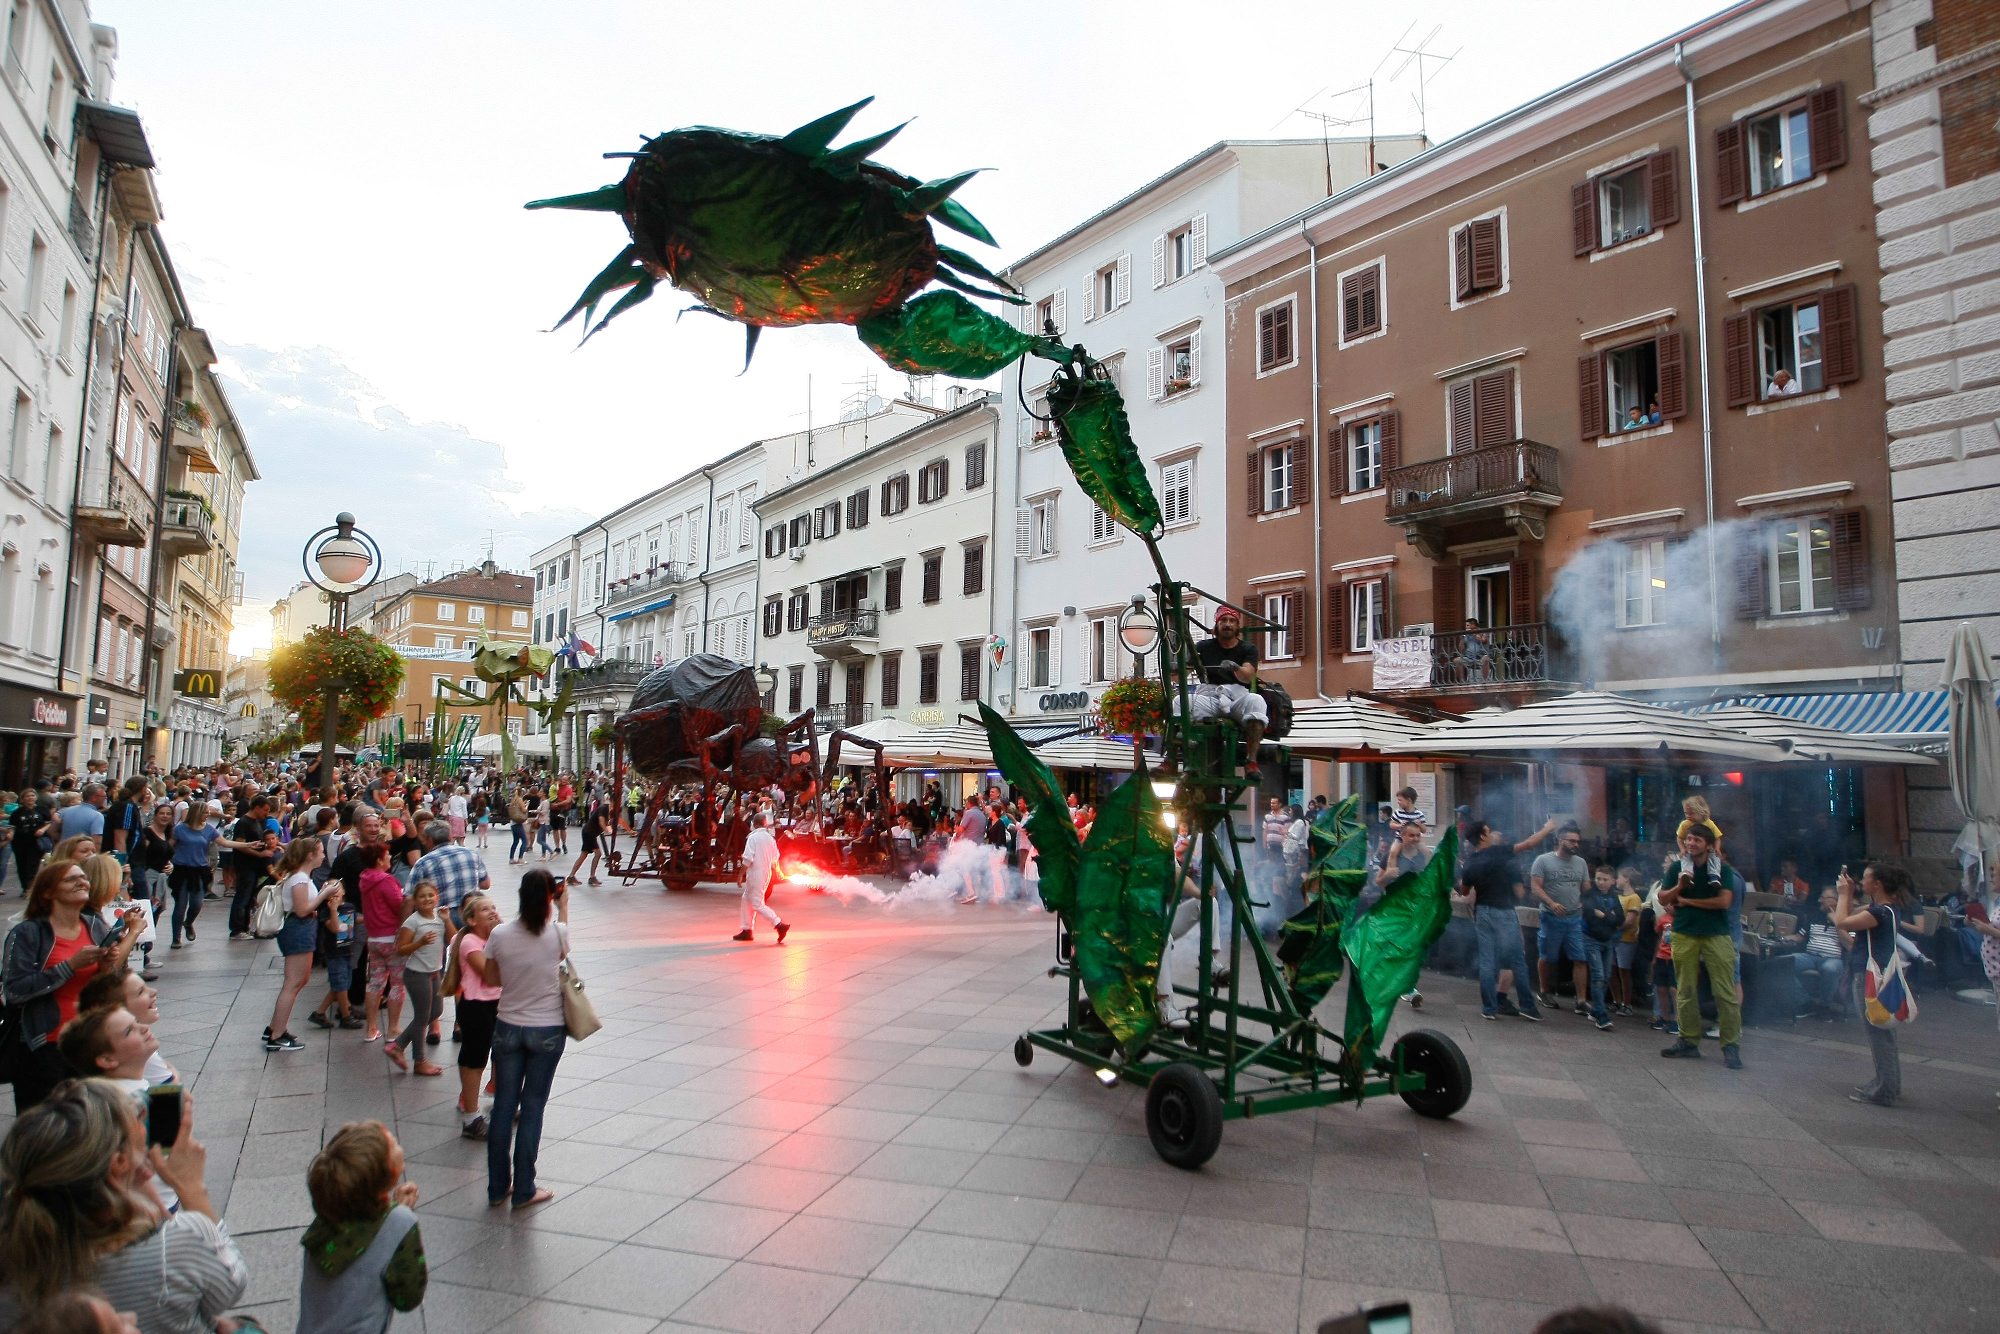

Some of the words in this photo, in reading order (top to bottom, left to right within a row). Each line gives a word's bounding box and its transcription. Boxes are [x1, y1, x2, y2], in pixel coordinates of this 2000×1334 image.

[811, 626, 828, 637] HAPPY
[828, 623, 848, 634] HOSTEL
[1039, 691, 1088, 710] CORSO
[910, 710, 944, 723] CARPISA
